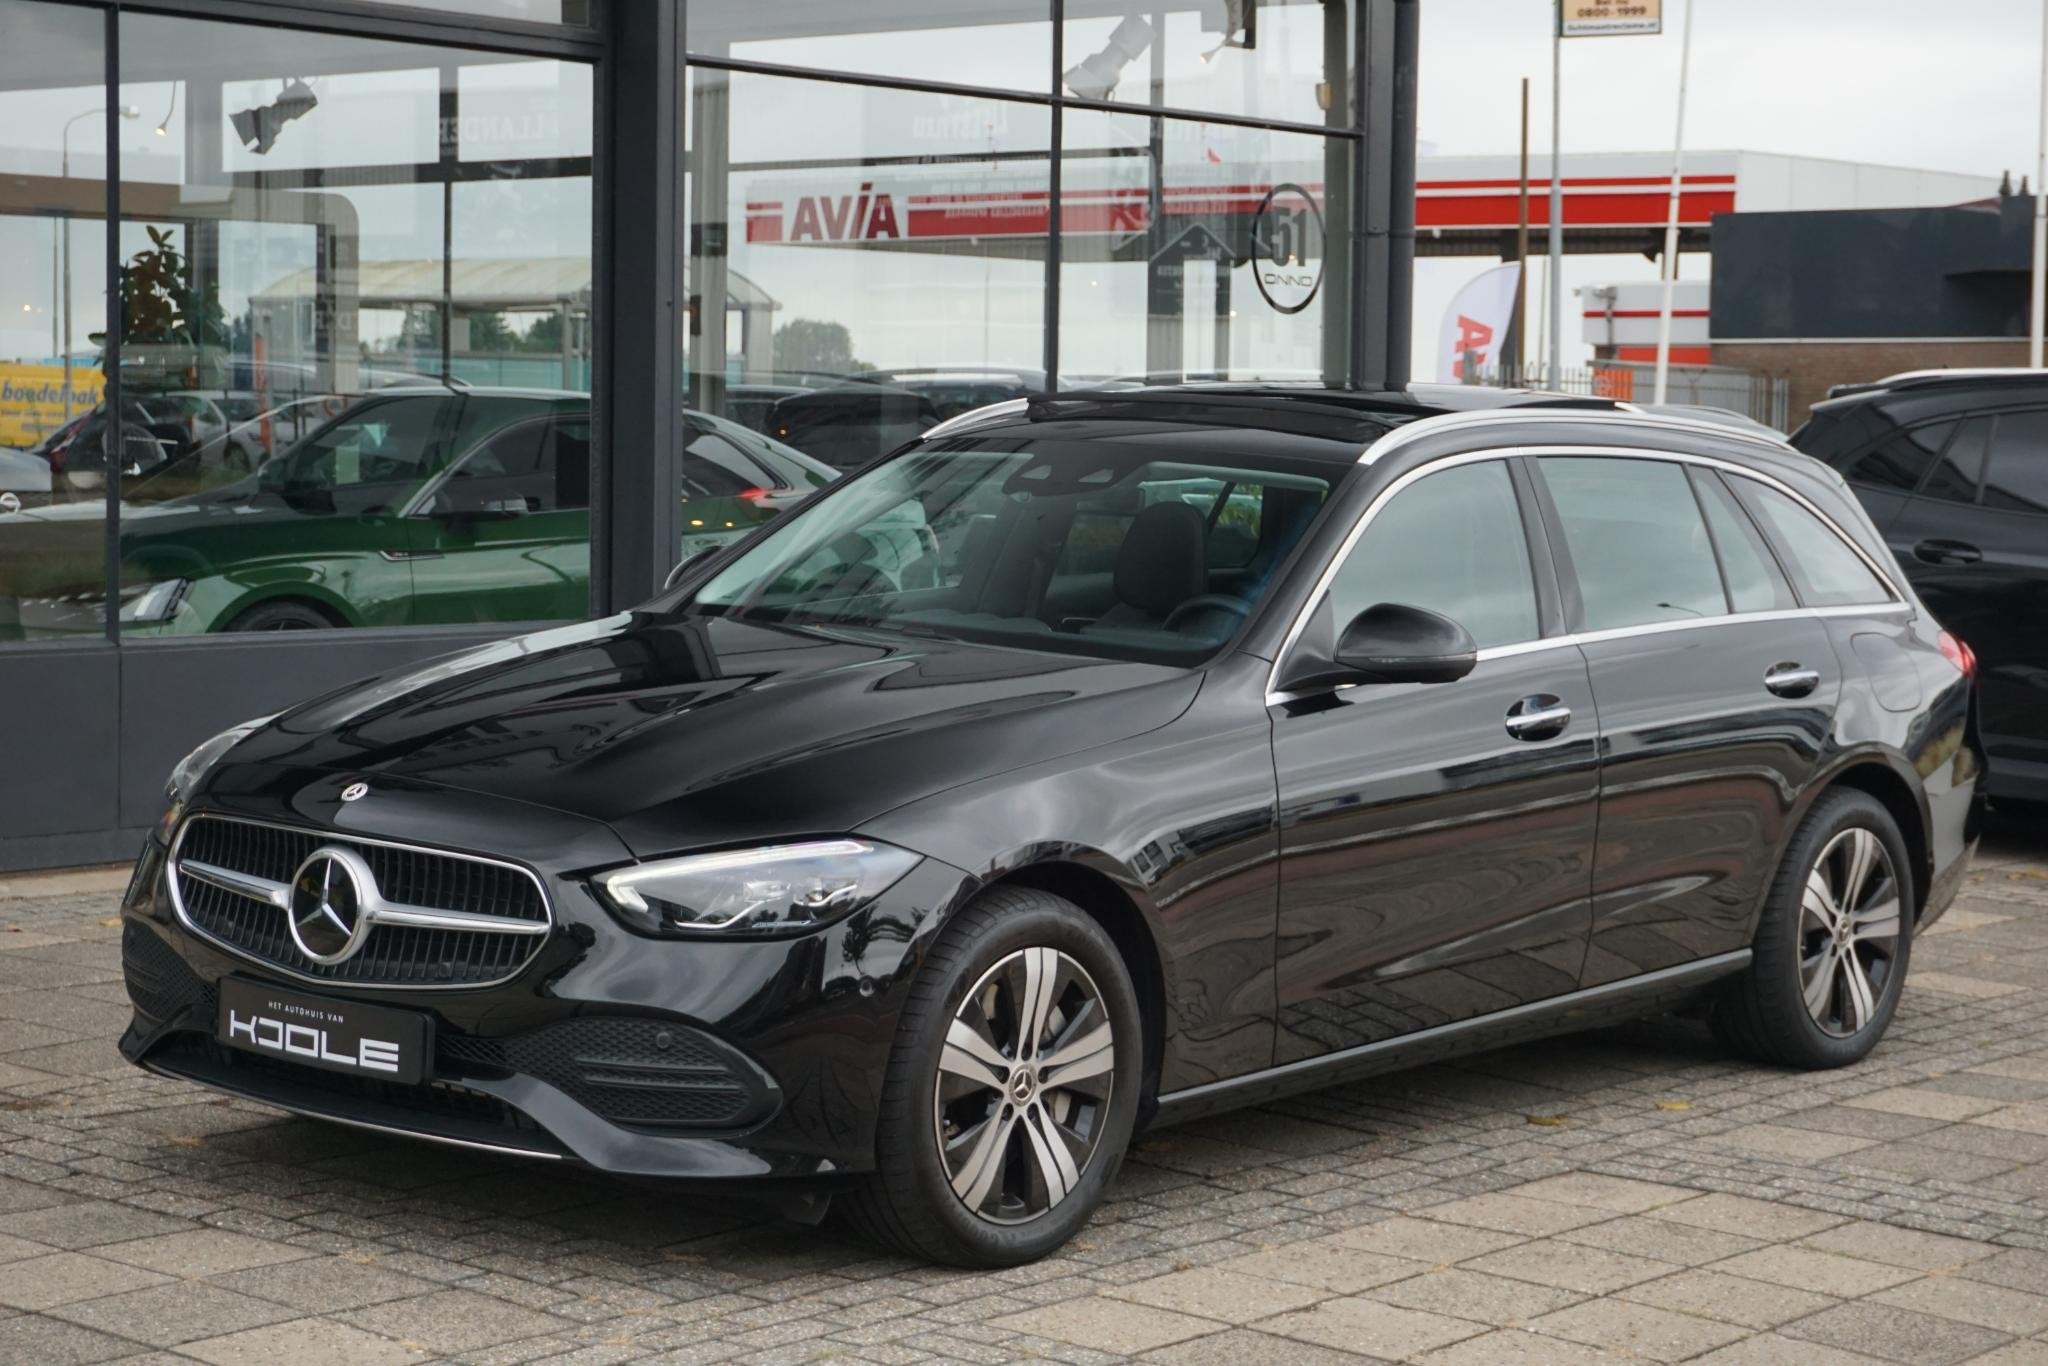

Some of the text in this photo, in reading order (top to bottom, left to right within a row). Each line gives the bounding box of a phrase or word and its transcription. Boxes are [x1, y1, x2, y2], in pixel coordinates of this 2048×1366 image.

[1271, 206, 1306, 267] 51
[229, 1009, 399, 1072] KOOLE
[268, 1000, 344, 1024] HET AUTOHUIS VAN
